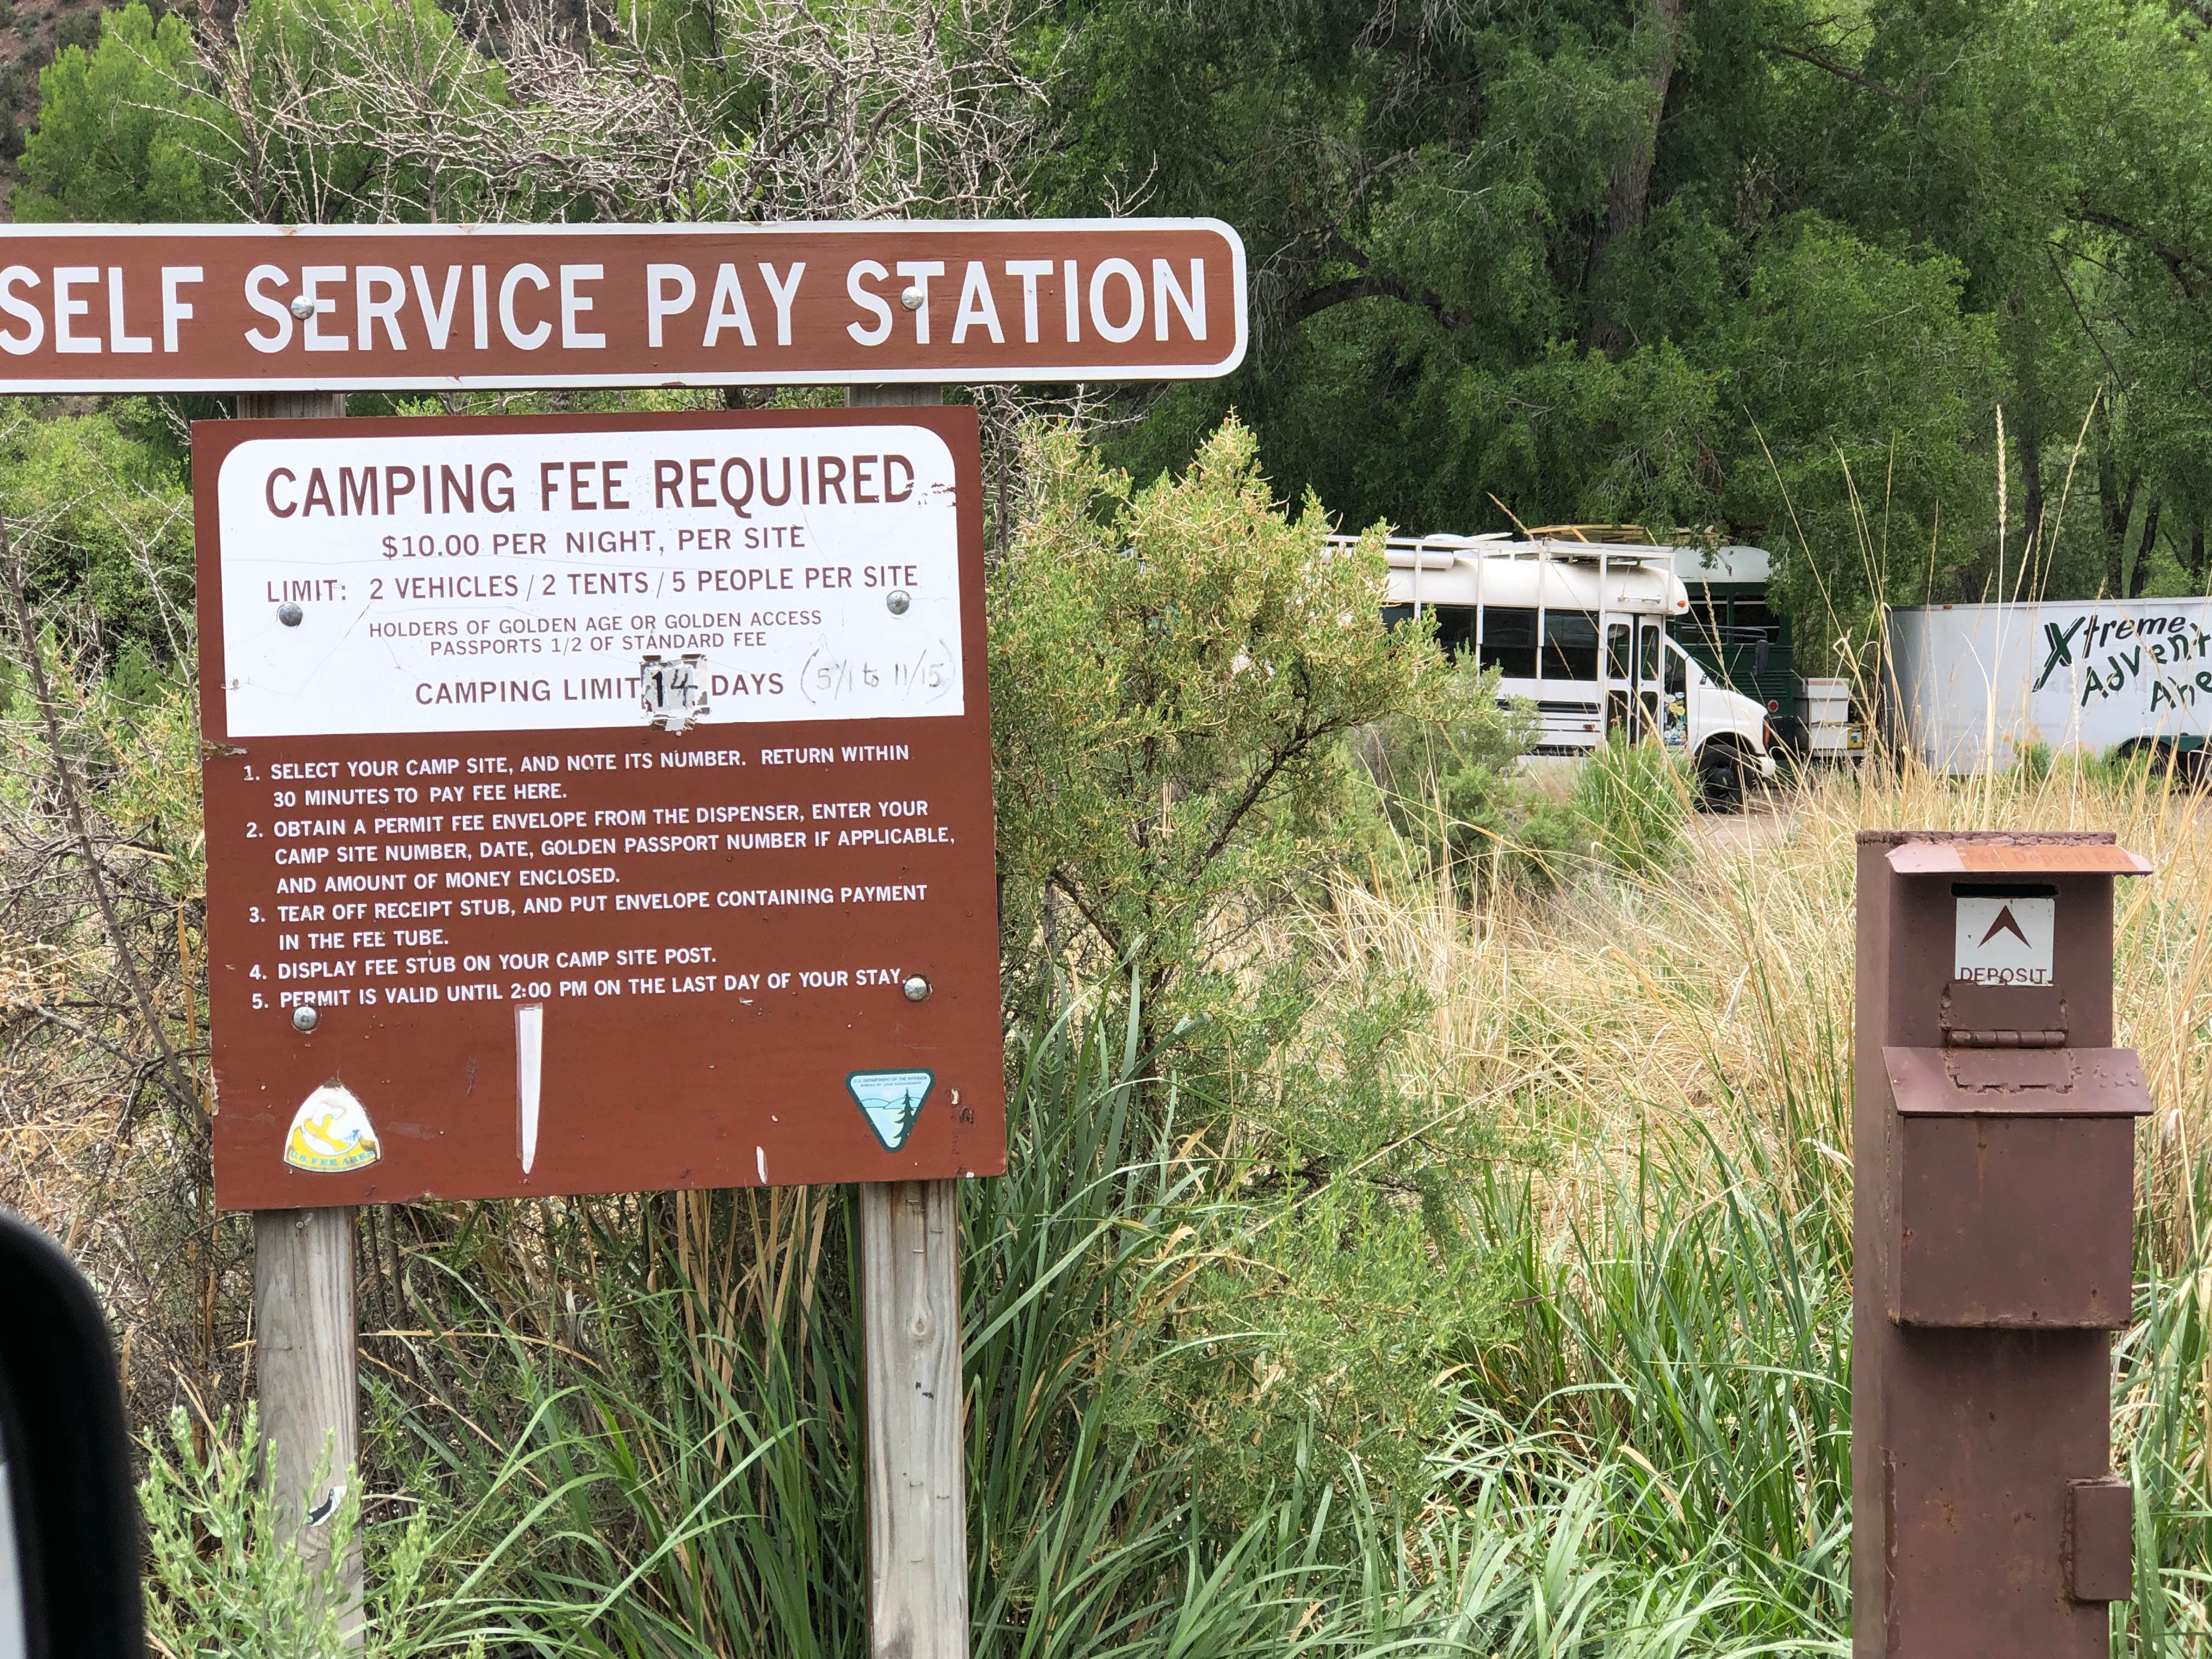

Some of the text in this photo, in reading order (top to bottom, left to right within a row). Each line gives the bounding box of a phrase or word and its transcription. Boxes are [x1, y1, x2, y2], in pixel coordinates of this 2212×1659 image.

[0, 258, 1206, 355] SELF SERVICE PAY STATION
[266, 455, 915, 518] CAMPING FEE REQUIRED
[382, 524, 804, 560] $10.00 PER NIGHT, PER SITE
[268, 579, 346, 602] LIMIT:
[395, 575, 518, 599] VEHICLES
[567, 572, 648, 594] TENTS
[698, 568, 793, 591] PEOPLE
[806, 567, 851, 588] PER
[865, 566, 917, 586] SITE
[370, 611, 821, 637] HOLDERS OF GOLDEN AGE OR GOLDEN ACCESS
[431, 631, 766, 655] PASSPORTS 1/2 OF STANDARD FEE
[2032, 615, 2186, 692] Xtreme
[862, 661, 879, 687] to
[2081, 623, 2212, 707] Advent
[416, 669, 783, 708] CAMPING LIMIT 14 DAYS
[244, 745, 909, 780] 1. SELECT YOUR CAMP SITE, AND NOTE ITS NUMBER. RETURN WITHIN
[274, 783, 566, 807] 30 MINUTES TO PAY FEE HERE.
[247, 801, 928, 837] 2. OBTAIN A PERMIT FEE ENVELOPE FROM THE DISPENSER, ENTER YOUR
[275, 827, 954, 864] CAMP SITE NUMBER, DATE, GOLDEN PASSPORT NUMBER IF APPLICABLE,
[277, 868, 619, 893] AND AMOUNT OF MONEY ENCLOSED.
[250, 885, 927, 922] 3. TEAR OFF RECEIPT STUB, AND PUT ENVELOPE CONTAINING PAYMENT
[280, 929, 448, 950] IN THE FEE TUBE.
[250, 947, 715, 980] 4. DISPLAY FEE STUB ON YOUR CAMP SITE POST.
[1960, 967, 2047, 984] DEPOSIT
[252, 968, 907, 1009] 5. PERMIT IS VALID UNTIL 2:00 PM ON THE LAST DAY OF YOUR STAY.
[311, 1157, 337, 1166] FEE
[342, 1150, 375, 1165] AREA
